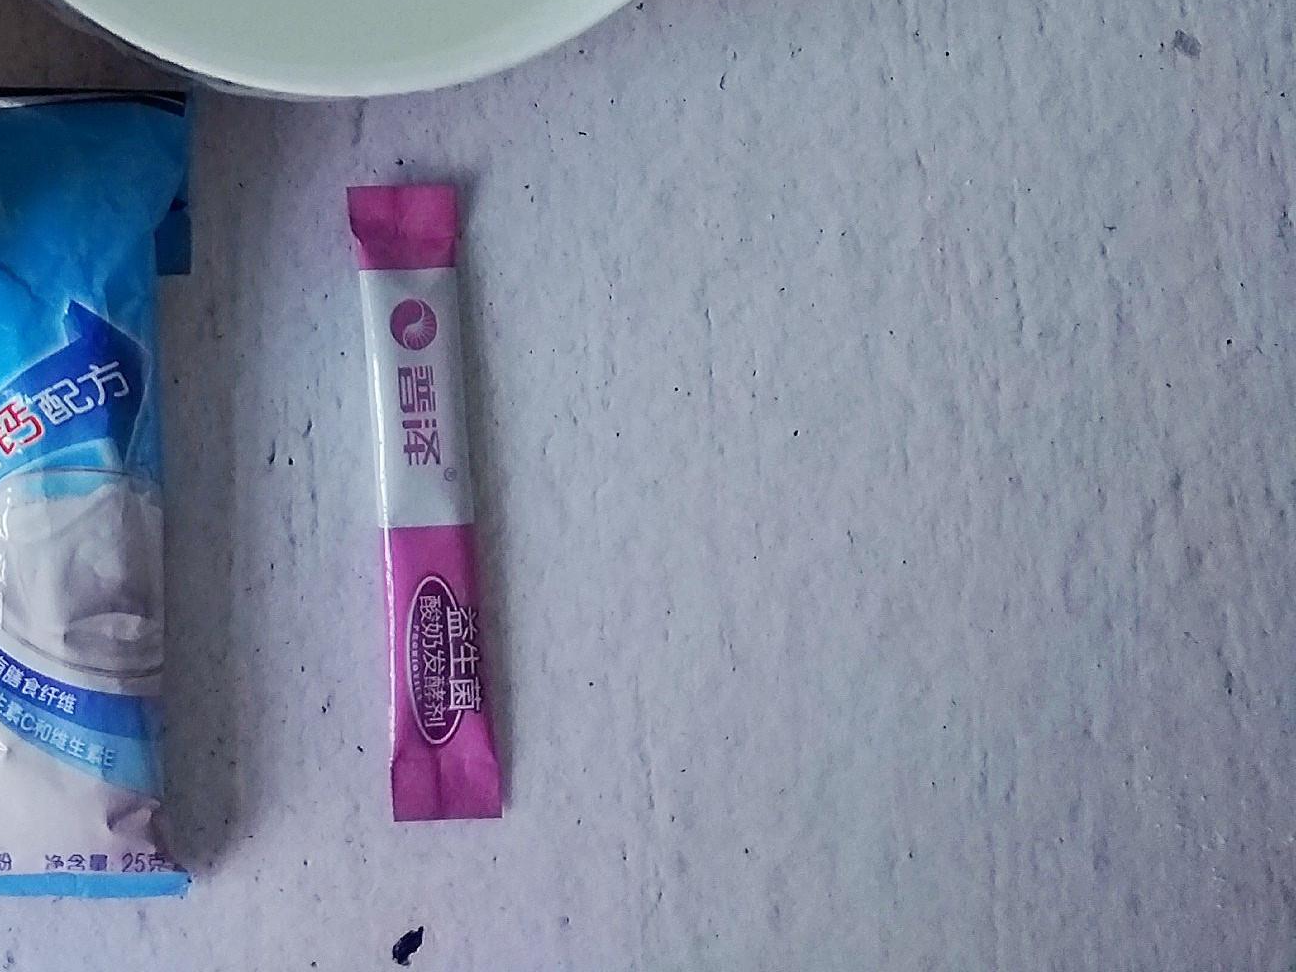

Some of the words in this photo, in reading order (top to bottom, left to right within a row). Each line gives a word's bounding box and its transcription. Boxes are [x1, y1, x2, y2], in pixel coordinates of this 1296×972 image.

[418, 594, 448, 728] 酸奶发酵剂
[446, 605, 481, 712] 益生菌
[45, 853, 108, 873] 净含量
